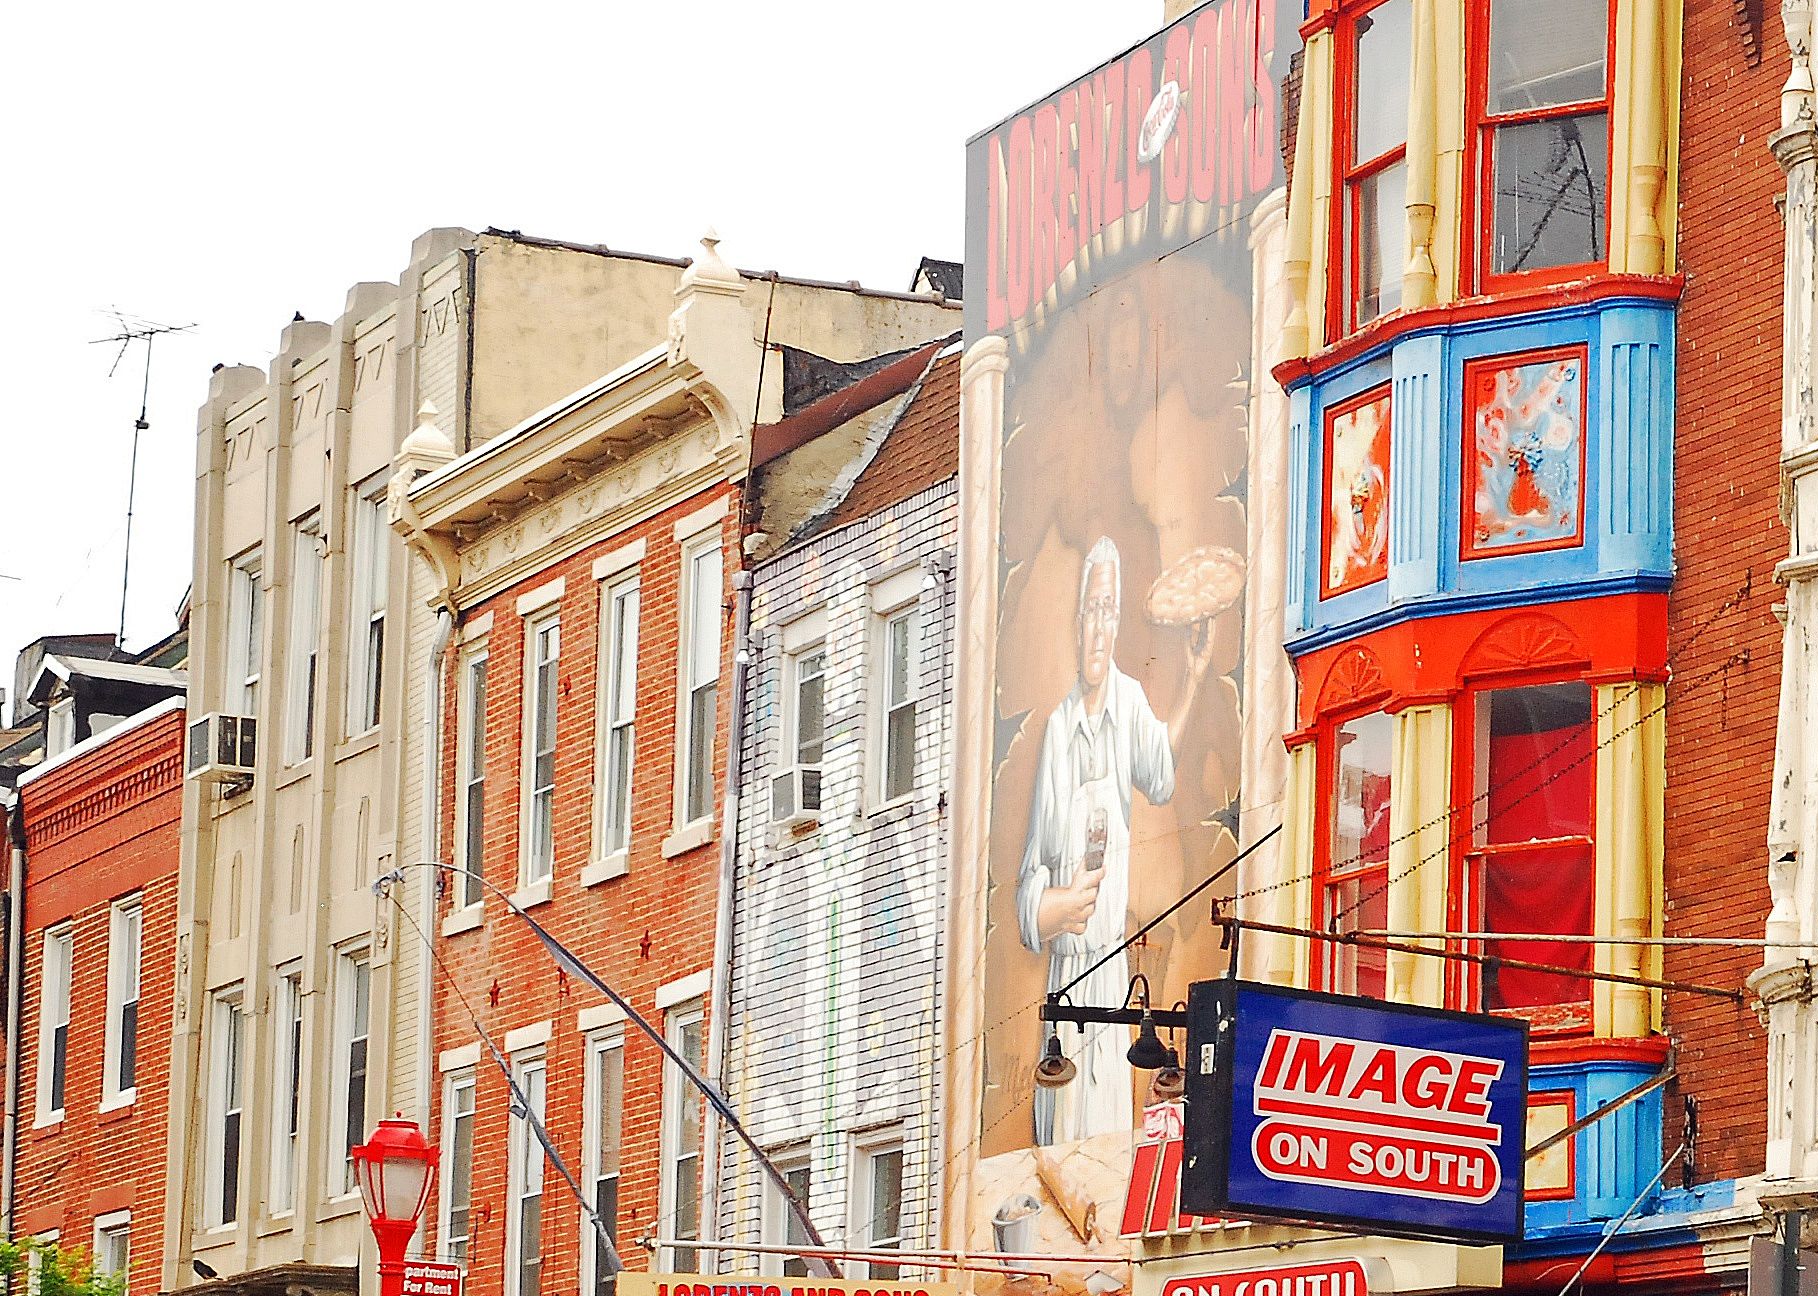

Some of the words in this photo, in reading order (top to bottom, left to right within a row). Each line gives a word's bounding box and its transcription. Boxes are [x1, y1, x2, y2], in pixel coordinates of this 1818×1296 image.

[987, 48, 1152, 332] LORENZO
[1163, 0, 1276, 206] SONS
[1258, 1032, 1502, 1119] IMAGE
[1270, 1131, 1325, 1169] ON
[1348, 1141, 1485, 1191] SOUTH
[403, 1280, 422, 1293] For
[424, 1282, 452, 1295] Rent
[404, 1266, 459, 1280] partment
